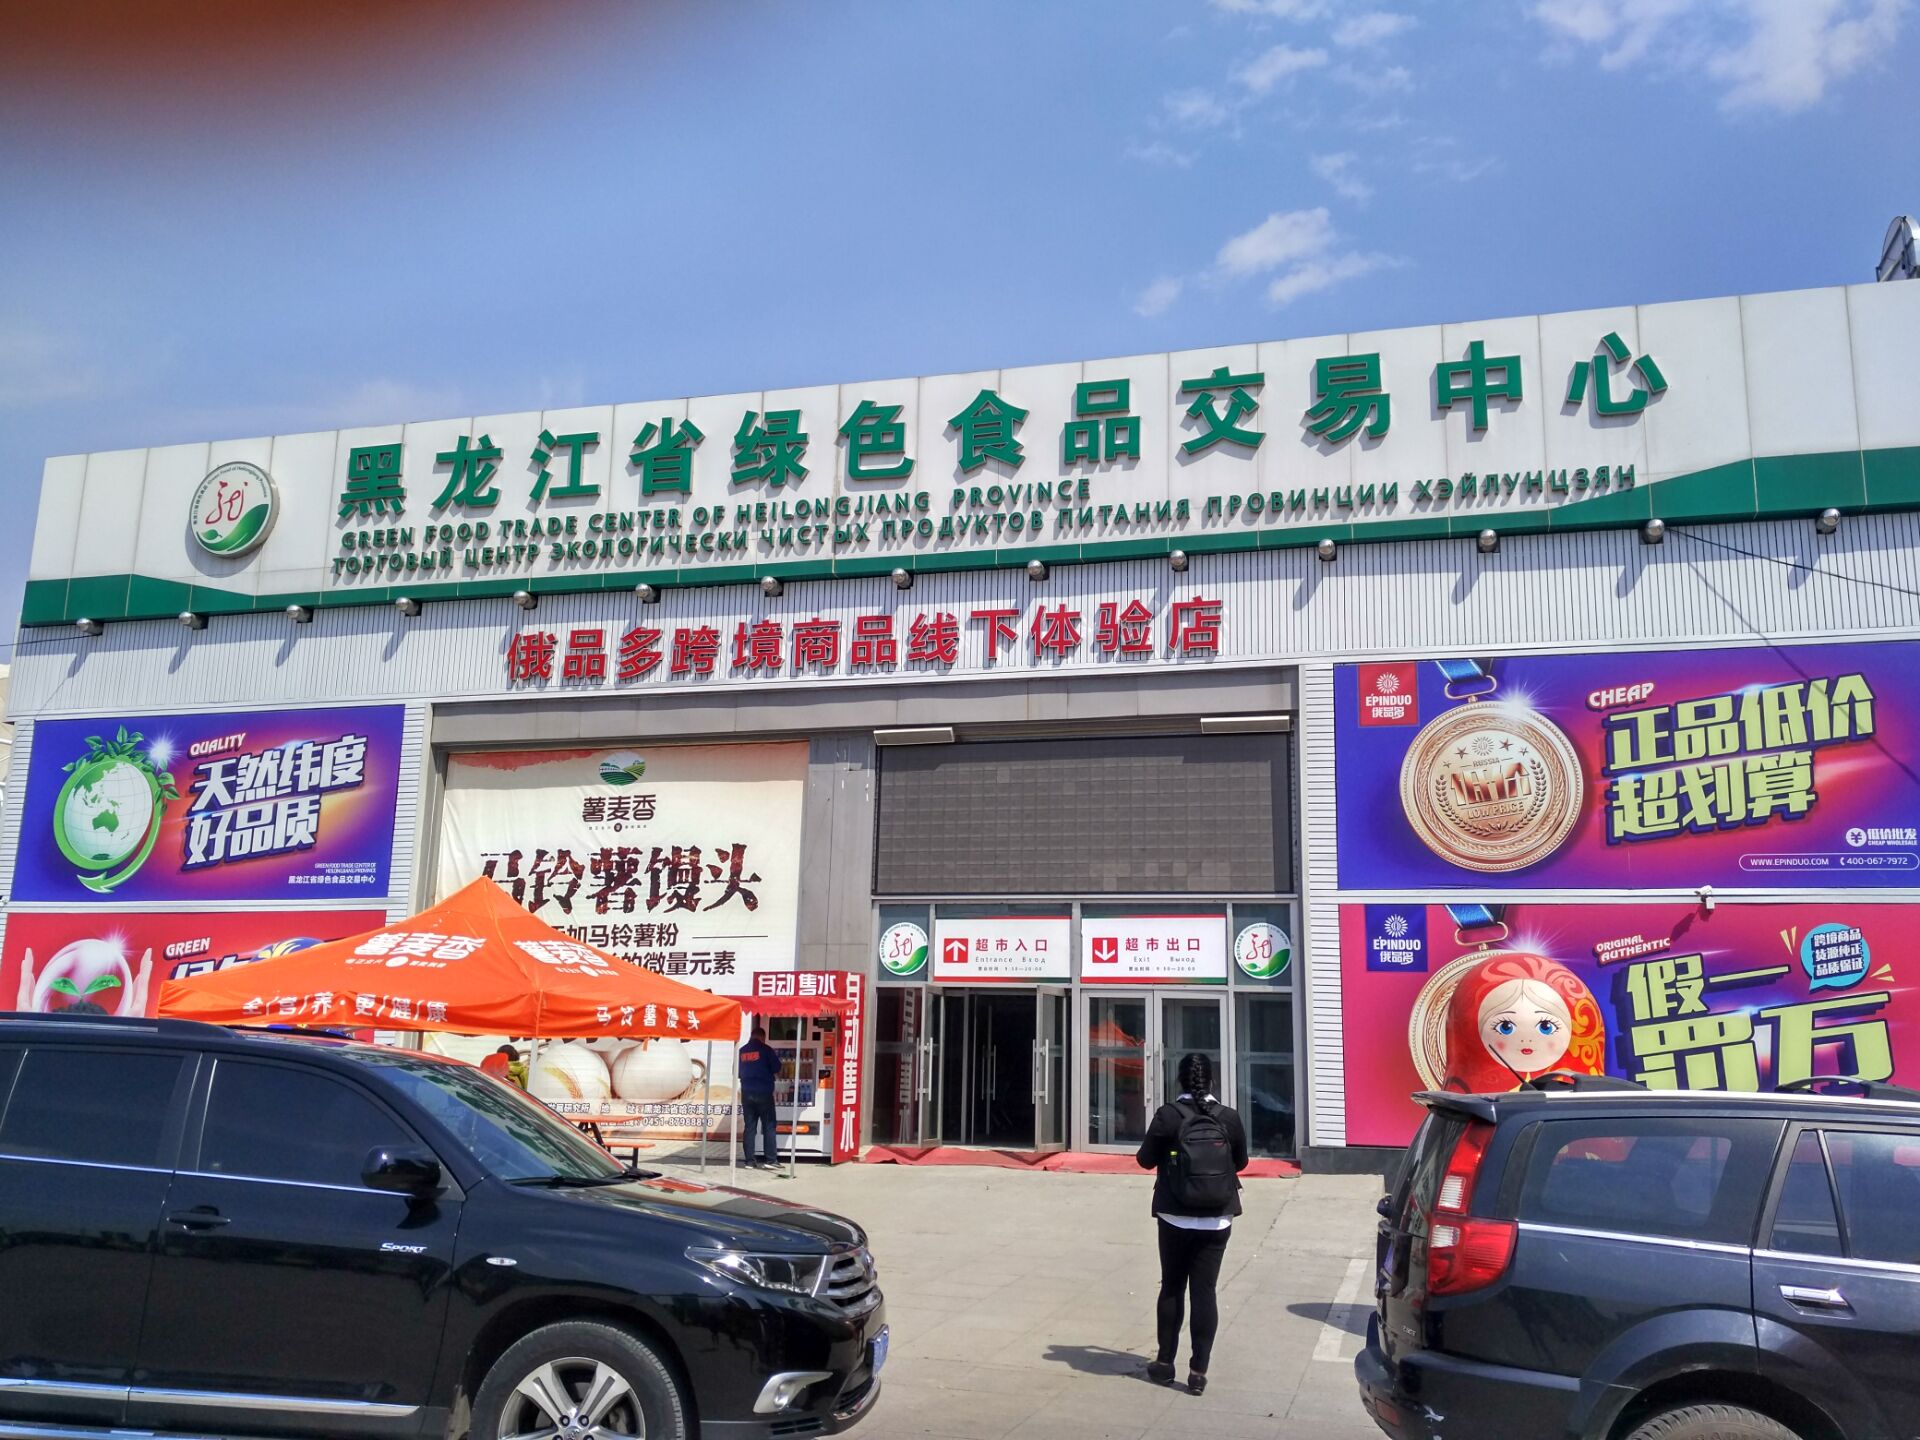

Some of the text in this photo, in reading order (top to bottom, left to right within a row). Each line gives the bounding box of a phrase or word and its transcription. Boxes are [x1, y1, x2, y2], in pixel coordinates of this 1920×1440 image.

[338, 331, 1668, 518] 黑龙江省绿色食品交易中心
[332, 464, 1637, 575] ТОРГОВЫЙ ЦЕНТР ЭКОЛОГИЧЕСКИ ЧИСТЫХ ПРОДУКТОВ ПИТАНИЯ ПРОВИНЦИИ ХЭЙЛУНЦЗЯН
[341, 478, 1090, 549] GREEN FOOD TRADE CENTER OF HEILONGJIANG PROVINCE
[508, 597, 1223, 683] 俄品多跨境商品线下体验店
[1589, 683, 1654, 708] CHEAP
[1610, 674, 1874, 770] 正品低价
[190, 733, 246, 756] QUALITY
[191, 736, 367, 811] 天然纬度
[1473, 758, 1500, 767] RUSSIA
[1611, 751, 1816, 837] 超划算
[582, 794, 656, 822] 薯麦香
[1468, 802, 1524, 819] LOW PRICE
[187, 795, 321, 865] 好品质
[1750, 857, 1908, 866] WWW.EPINDUO.COM 400-067-7972
[288, 875, 376, 884] 黑龙江省绿色食品交易中心
[480, 843, 761, 914] 马铃薯馒头
[166, 937, 210, 956] GREEN
[551, 923, 679, 948] 加马铃薯粉
[975, 938, 1047, 951] 超市入口
[1125, 937, 1200, 951] 超市出口
[1596, 935, 1643, 952] ORIGINAL
[1814, 928, 1861, 947] 跨境商品
[1022, 956, 1046, 964] Вход
[1170, 956, 1195, 964] Выход
[1601, 938, 1670, 962] AUTHENTIC
[611, 951, 736, 976] 的微量元素
[1816, 957, 1863, 976] 品质保证
[758, 974, 836, 996] 自动售水
[1627, 954, 1789, 1020] 假一
[840, 972, 860, 1152] 自动售水
